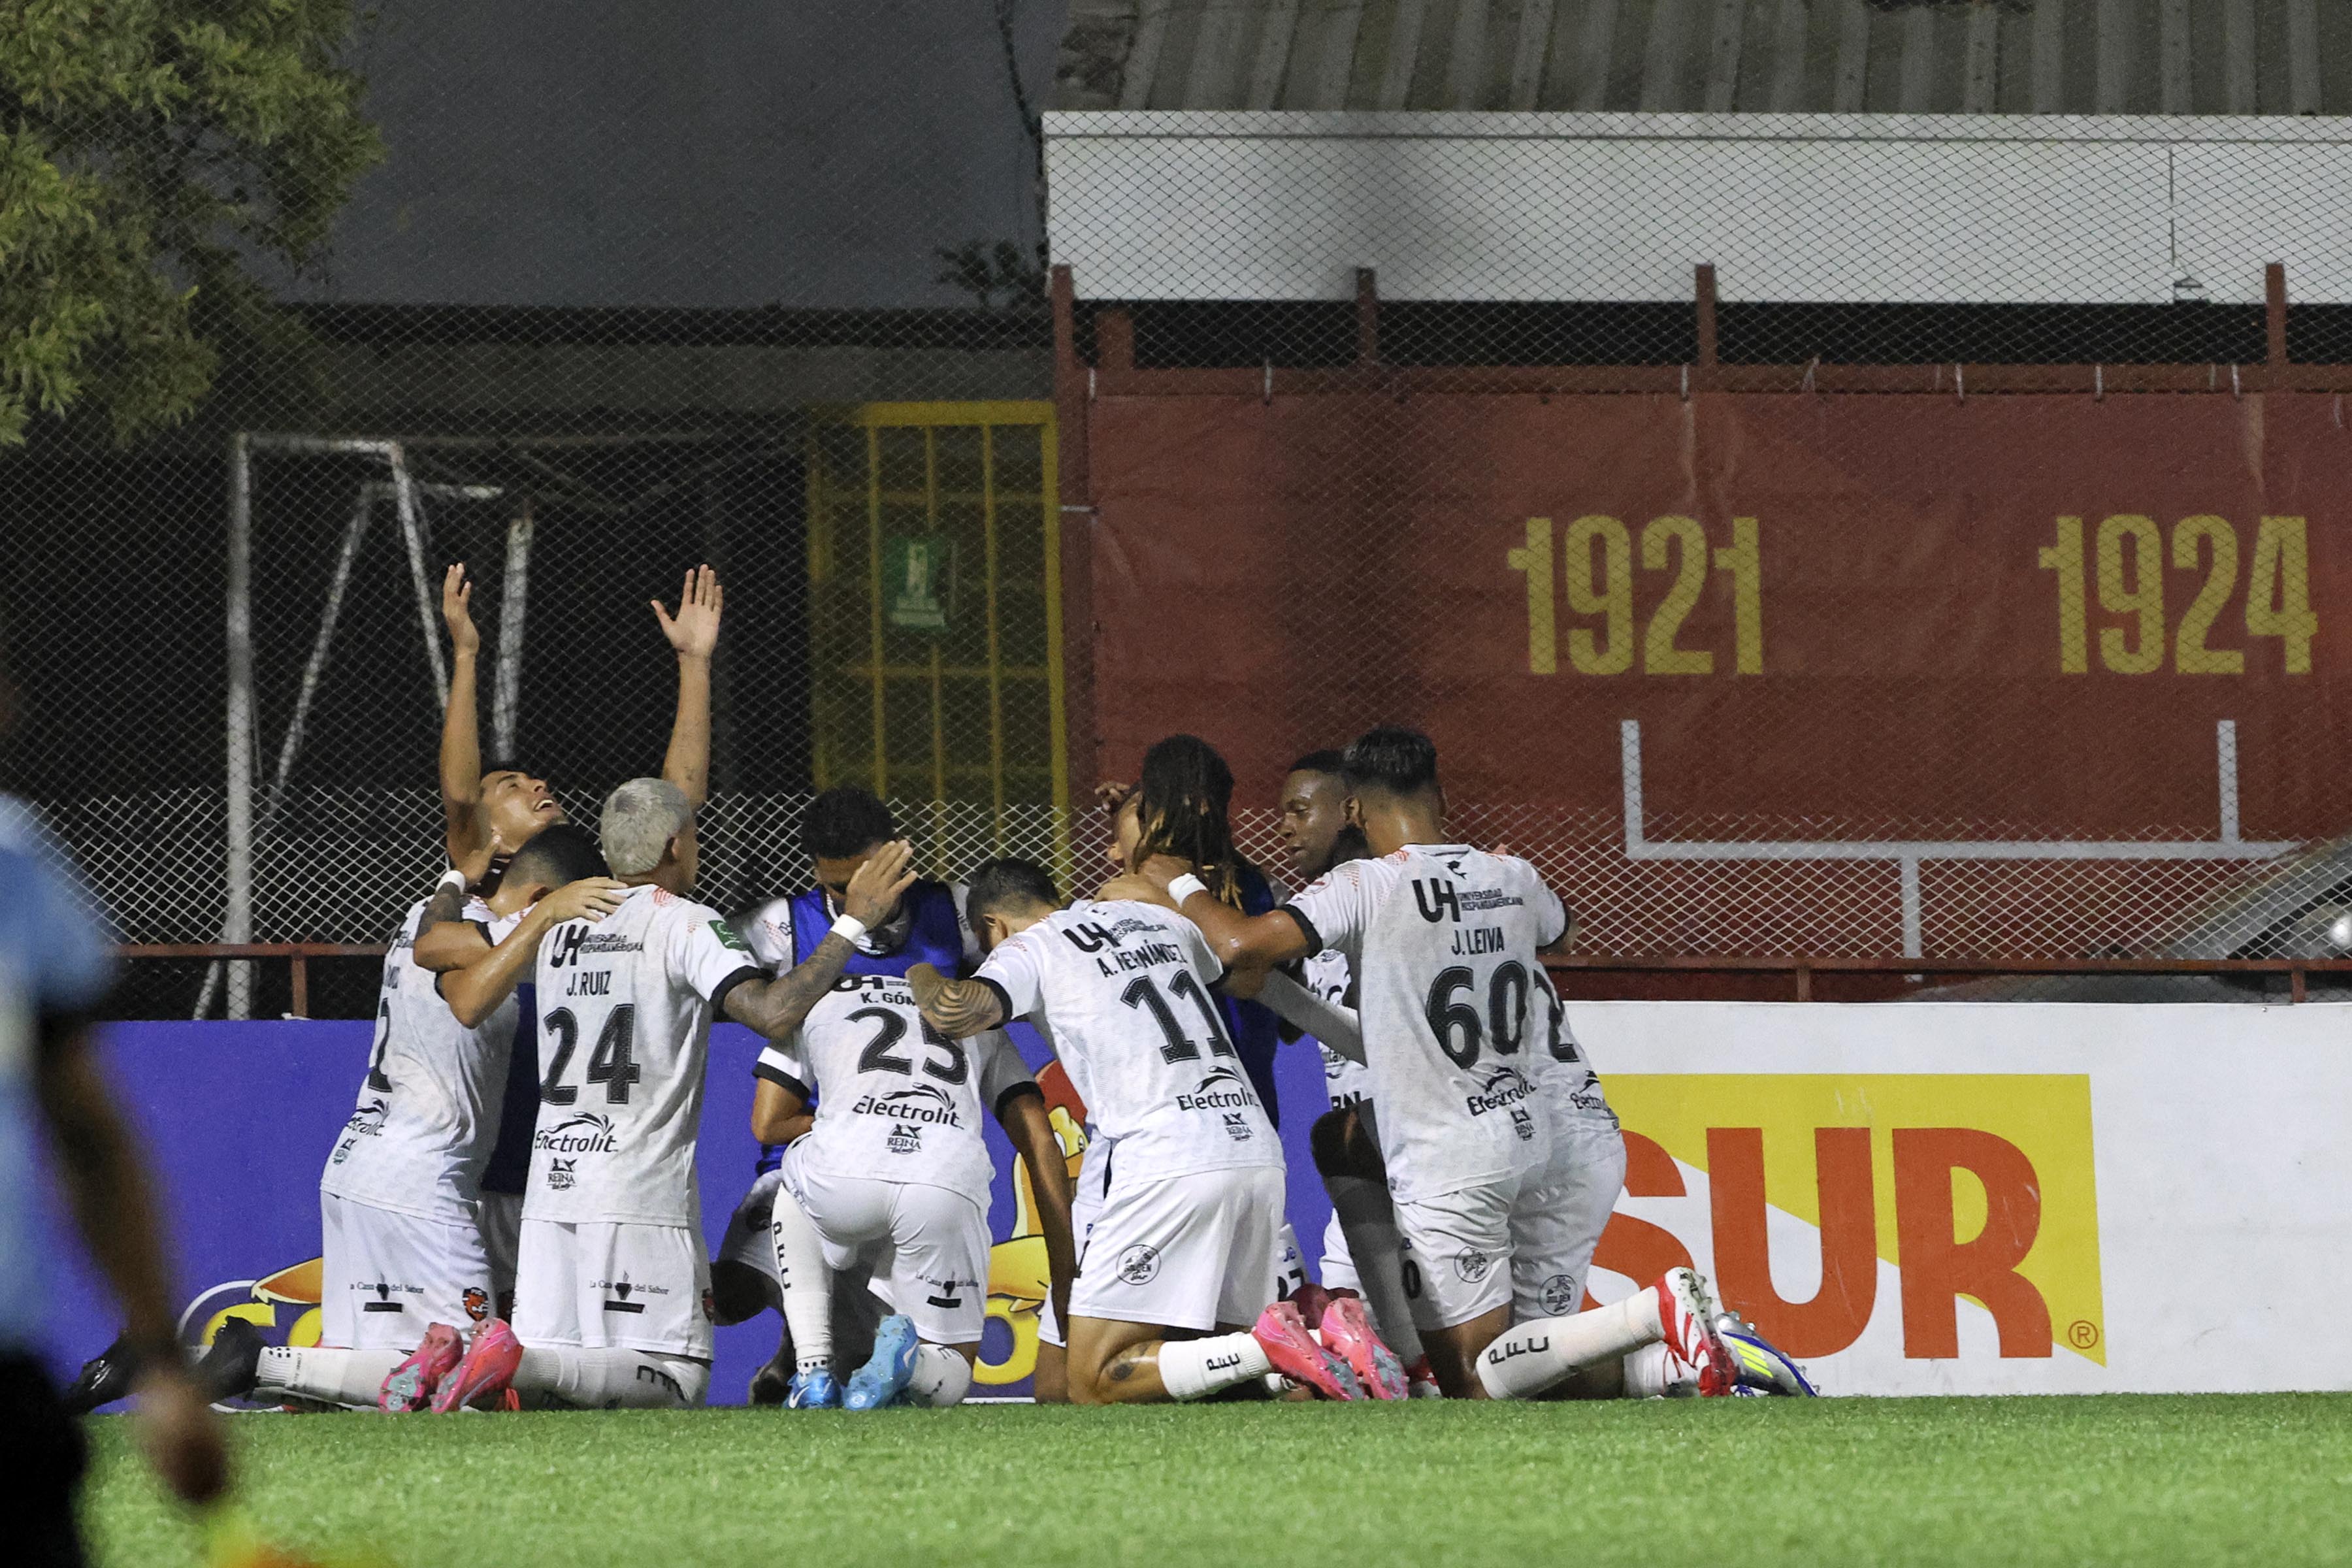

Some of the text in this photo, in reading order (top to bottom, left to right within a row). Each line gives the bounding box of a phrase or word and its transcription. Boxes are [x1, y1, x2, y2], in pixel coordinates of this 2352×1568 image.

[1507, 514, 1764, 674] 1921
[2038, 514, 2319, 674] 1924
[1412, 877, 1461, 923] UH
[540, 1004, 641, 1106] 24
[843, 1006, 970, 1086] 25
[1120, 969, 1237, 1065] 11
[1426, 960, 1528, 1070] 60
[851, 1095, 966, 1130] Electrolit
[887, 1137, 922, 1150] REINA
[1581, 1128, 2053, 1359] SUR
[1488, 1336, 1550, 1365] PFC
